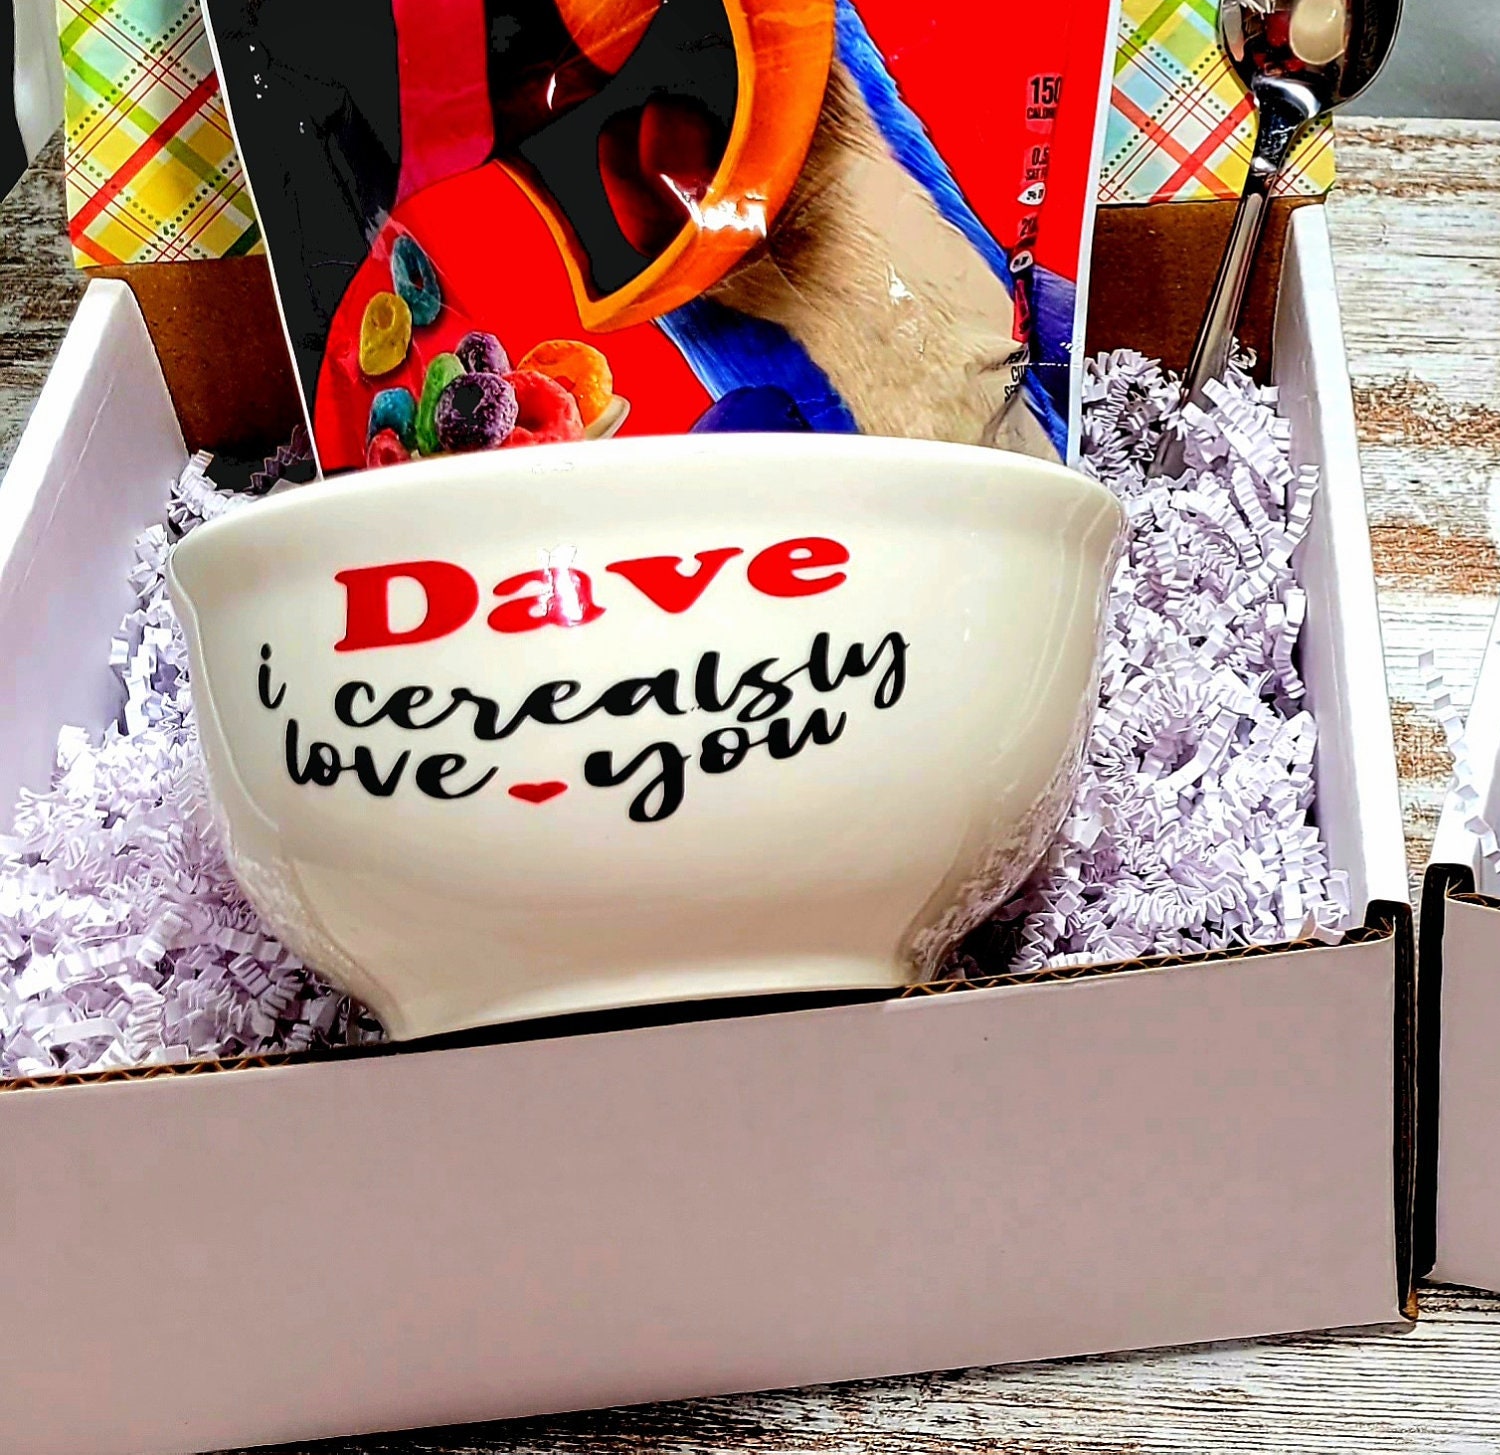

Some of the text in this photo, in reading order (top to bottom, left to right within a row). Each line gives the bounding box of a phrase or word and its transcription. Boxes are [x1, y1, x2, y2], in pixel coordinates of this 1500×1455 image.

[333, 536, 850, 653] Dave
[257, 630, 911, 741] i cerealsly
[284, 706, 848, 822] love you
